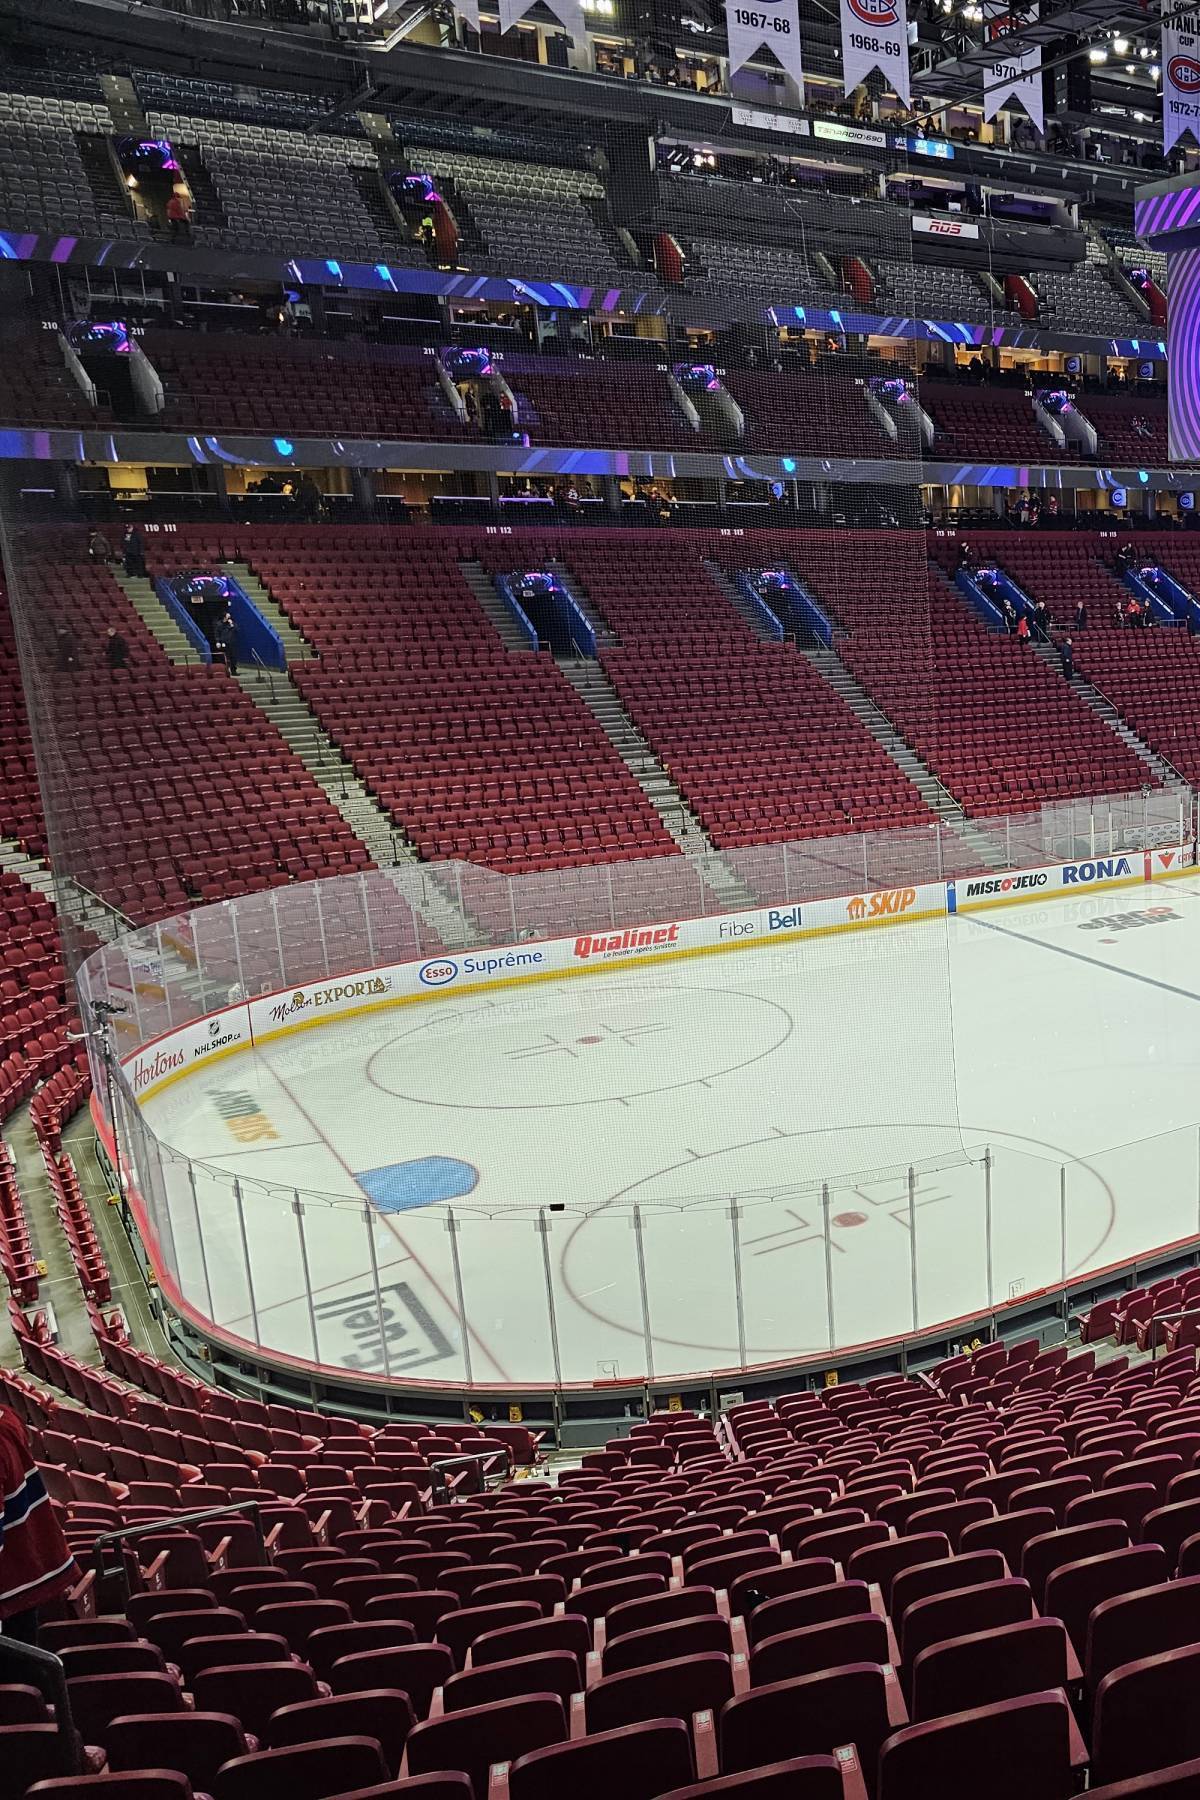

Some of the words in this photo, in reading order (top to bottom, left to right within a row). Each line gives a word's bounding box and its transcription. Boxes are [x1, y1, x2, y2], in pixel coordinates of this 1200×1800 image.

[735, 9, 791, 34] 1967-68
[849, 33, 900, 56] 1968-69
[1179, 35, 1195, 48] CUP
[929, 220, 962, 234] RDS
[42, 322, 58, 330] 210
[131, 328, 144, 336] 211
[492, 352, 504, 360] 212
[656, 364, 668, 372] 212
[144, 524, 159, 532] 110
[164, 524, 177, 532] 111
[486, 526, 497, 534] 111
[500, 526, 512, 534] 112
[1062, 858, 1132, 884] RONA
[868, 888, 916, 916] SKIP
[719, 921, 754, 938] Fibe
[768, 907, 802, 931] Bell
[573, 924, 680, 958] Qualinet
[425, 965, 453, 980] Esso
[464, 952, 543, 974] Suprême
[269, 997, 312, 1022] Molson
[314, 979, 375, 1007] EXPORT
[134, 1048, 184, 1092] Hortons
